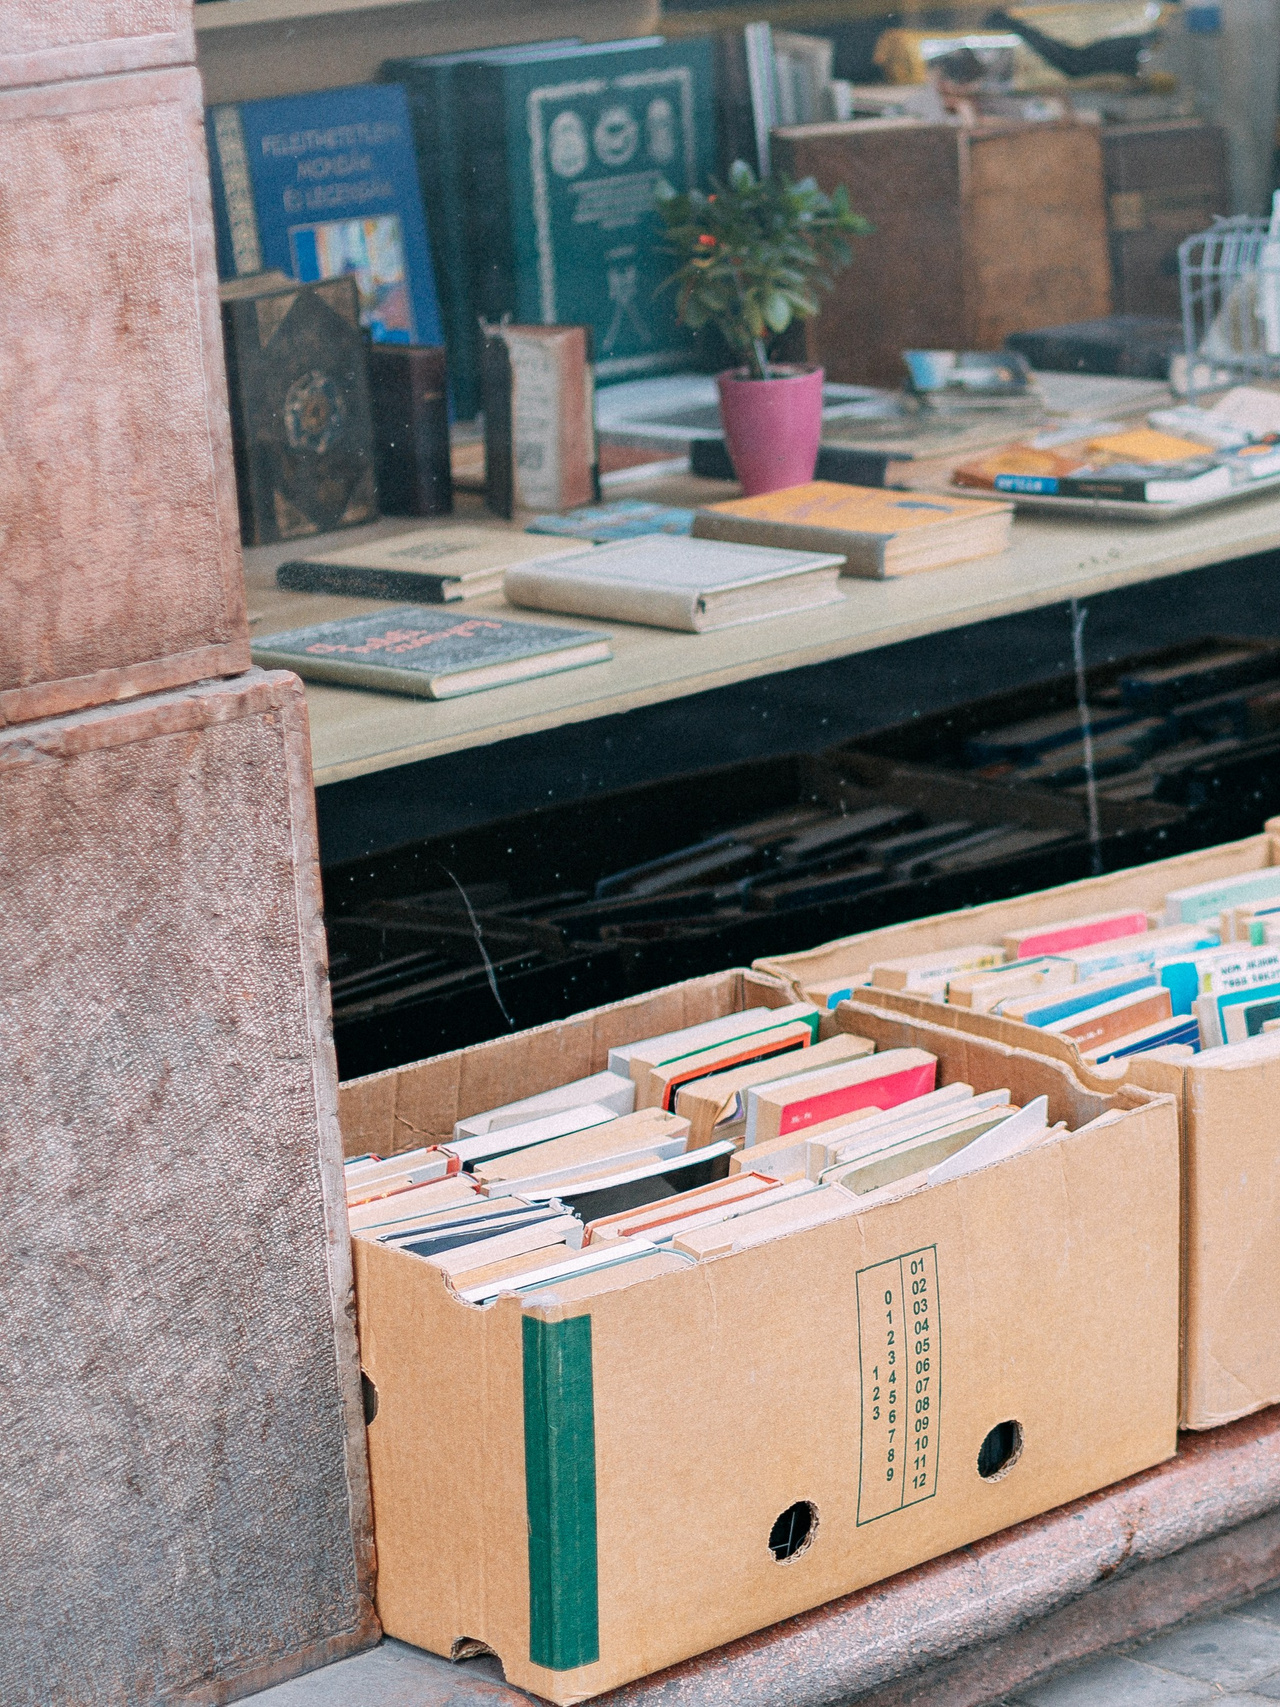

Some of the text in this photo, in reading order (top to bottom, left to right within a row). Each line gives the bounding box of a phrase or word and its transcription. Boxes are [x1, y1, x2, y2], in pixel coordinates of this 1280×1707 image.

[910, 1257, 924, 1276] 01
[911, 1277, 927, 1296] 02
[884, 1289, 893, 1305] 0
[913, 1298, 928, 1316] 03
[886, 1310, 893, 1325] 1
[914, 1317, 930, 1335] 04
[887, 1330, 895, 1346] 2
[915, 1337, 931, 1355] 05
[888, 1350, 896, 1365] 3
[872, 1365, 879, 1381] 1
[915, 1357, 931, 1375] 06
[888, 1370, 897, 1384] 4
[915, 1376, 930, 1394] 07
[872, 1386, 880, 1402] 2
[888, 1389, 897, 1405] 5
[872, 1405, 881, 1421] 3
[915, 1396, 930, 1414] 08
[888, 1409, 897, 1424] 6
[914, 1416, 930, 1433] 09
[888, 1428, 896, 1444] 7
[914, 1435, 929, 1452] 10
[887, 1448, 895, 1463] 8
[914, 1454, 926, 1471] 11
[886, 1467, 894, 1482] 9
[912, 1472, 927, 1489] 12
